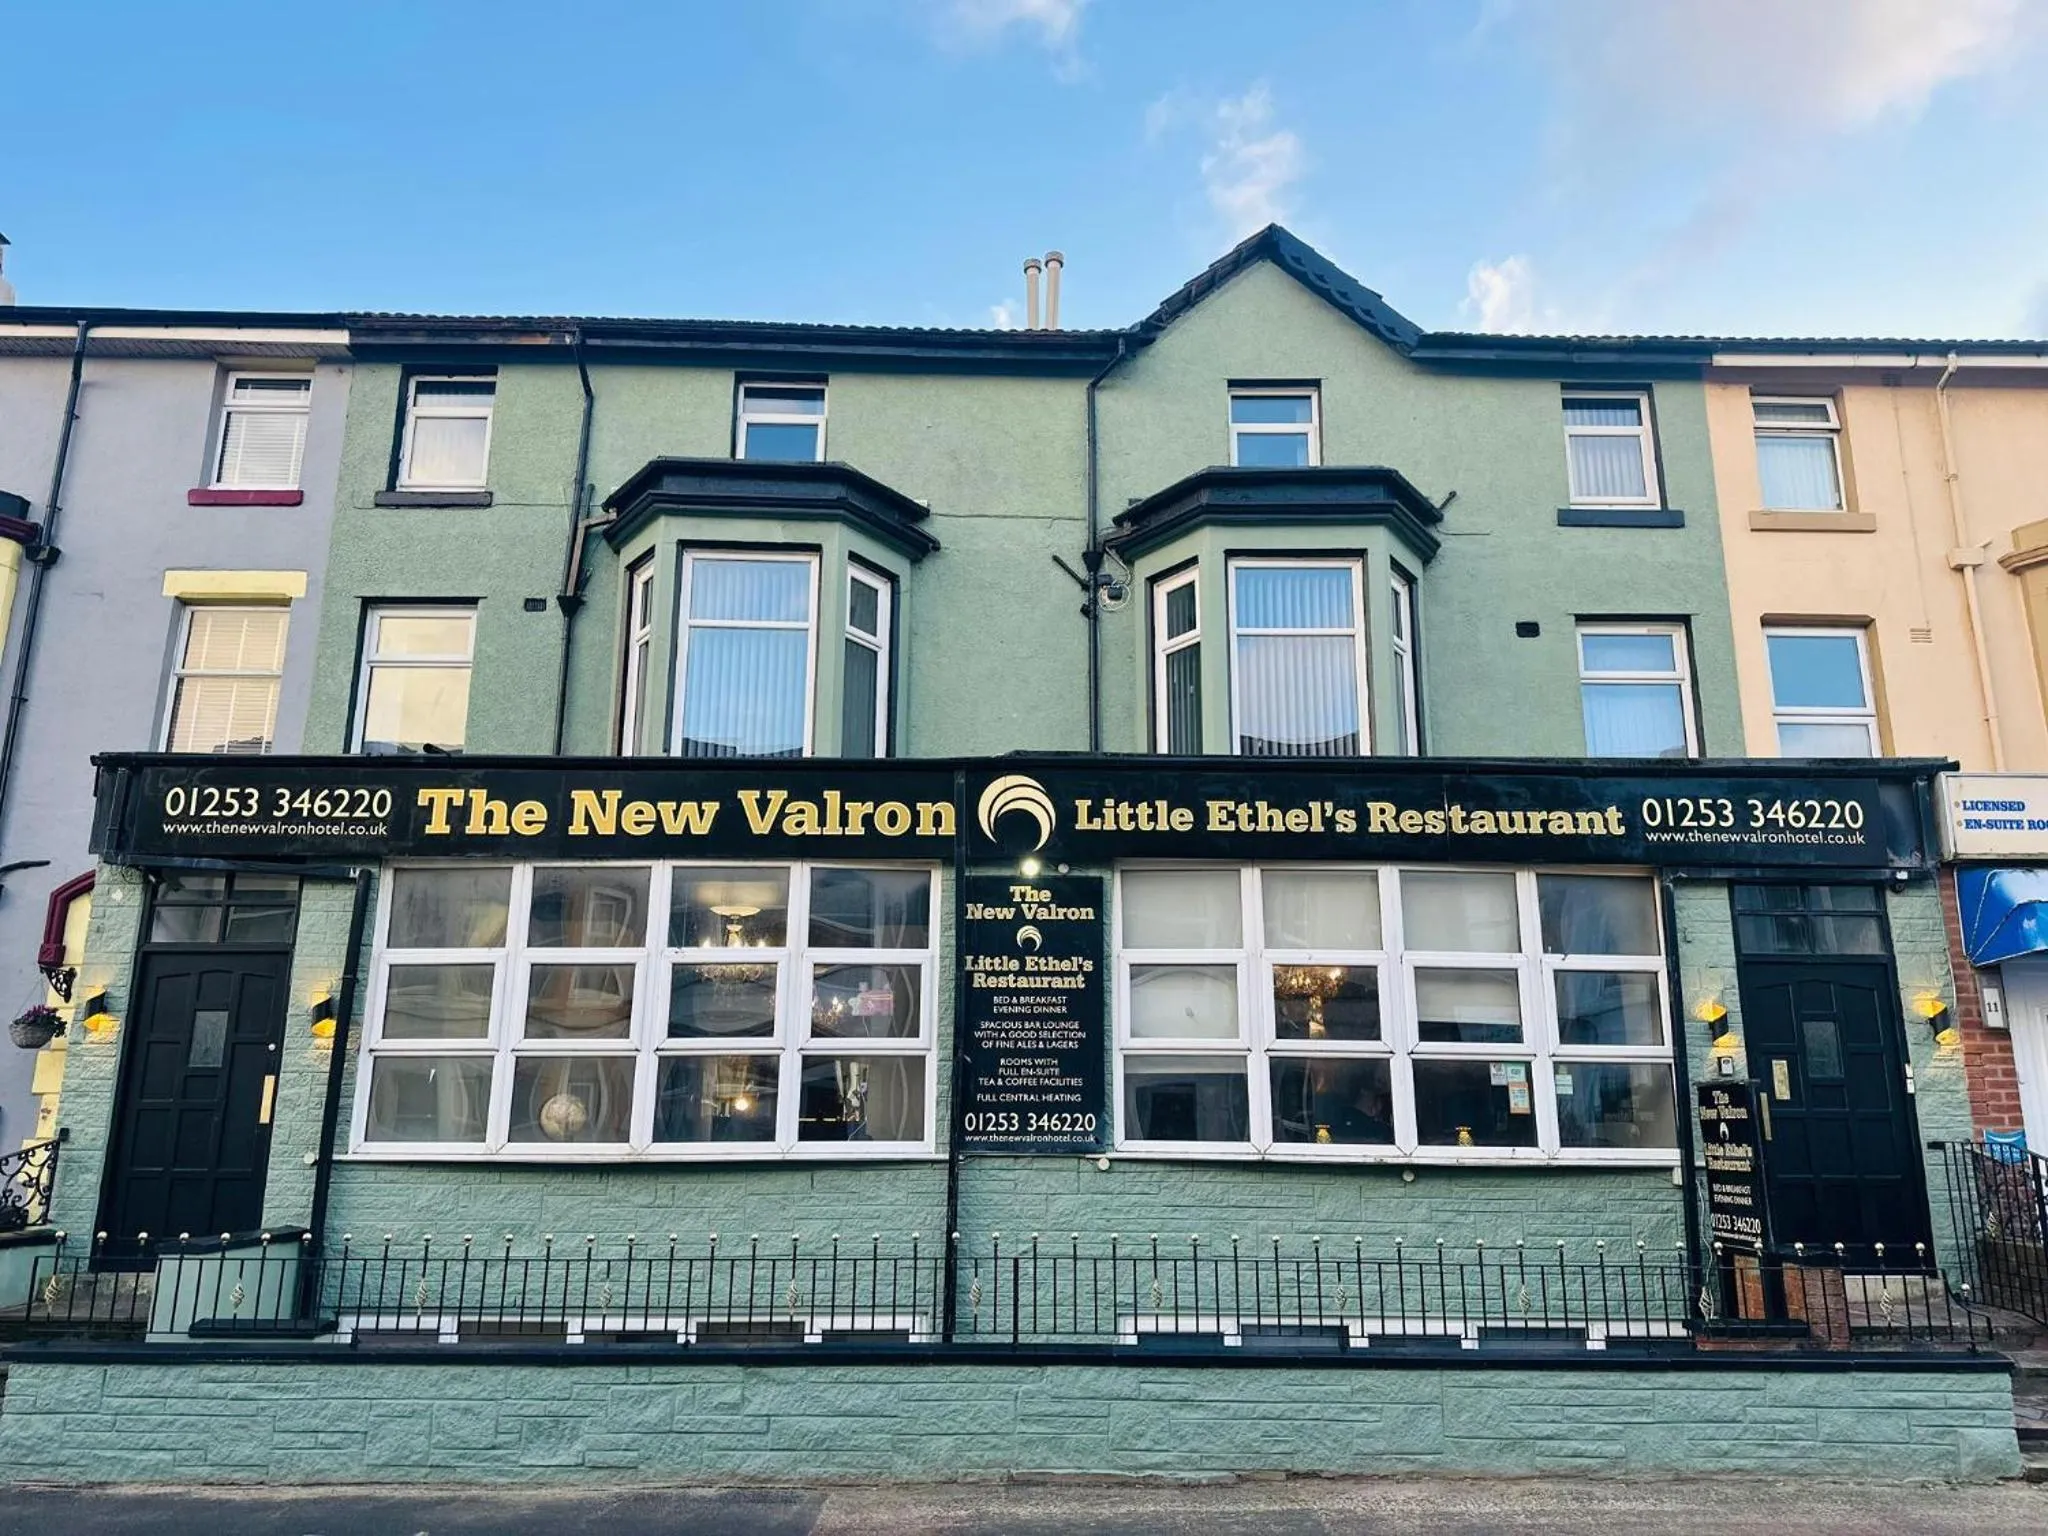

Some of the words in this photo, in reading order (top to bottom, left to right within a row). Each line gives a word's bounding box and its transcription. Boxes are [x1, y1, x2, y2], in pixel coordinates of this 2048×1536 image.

[165, 787, 259, 818] 01253
[274, 788, 391, 818] 346220
[1962, 800, 2025, 811] LICENSED
[418, 788, 547, 835] The
[568, 789, 720, 835] New
[738, 789, 956, 836] Valron
[1075, 798, 1193, 831] Little
[1207, 800, 1356, 833] Ethel's
[1368, 802, 1626, 836] Restaurant
[1642, 797, 1733, 827] 01253
[1746, 798, 1864, 830] 346220
[162, 818, 387, 837] www.thenewvalronhotel.co.uk
[1964, 819, 2024, 830] EN-SUITE
[1644, 830, 1865, 846] www.thenewvalronhotel.co.uk
[1009, 885, 1051, 902] The
[966, 904, 1016, 920] New
[1021, 903, 1095, 920] Valron
[965, 956, 1020, 971] Little
[1025, 956, 1093, 972] Ethel's
[973, 972, 1085, 988] Restaurant
[1033, 1006, 1067, 1014] DINNER
[1986, 1002, 1999, 1012] 11
[980, 1021, 1022, 1029] SPACIOUS
[1024, 1021, 1041, 1029] BAR
[1043, 1021, 1080, 1029] LOUNGE
[1008, 1031, 1036, 1039] GOOD
[1038, 1031, 1086, 1039] SELECTION
[1047, 1041, 1078, 1049] LAGERS
[1000, 1058, 1032, 1066] ROOMS
[999, 1068, 1019, 1076] FULL
[1021, 1068, 1060, 1076] EN-SUITE
[1004, 1078, 1038, 1086] COFFEE
[1040, 1078, 1083, 1086] FACILITIES
[999, 1094, 1040, 1102] CENTRAL
[1042, 1094, 1081, 1102] HEATING
[965, 1113, 1019, 1131] 01253
[1027, 1113, 1096, 1131] 346220
[965, 1134, 1096, 1143] www.thenewvalronhotel.co.uk
[1711, 1213, 1731, 1230] 01253
[1732, 1216, 1761, 1233] 346220
